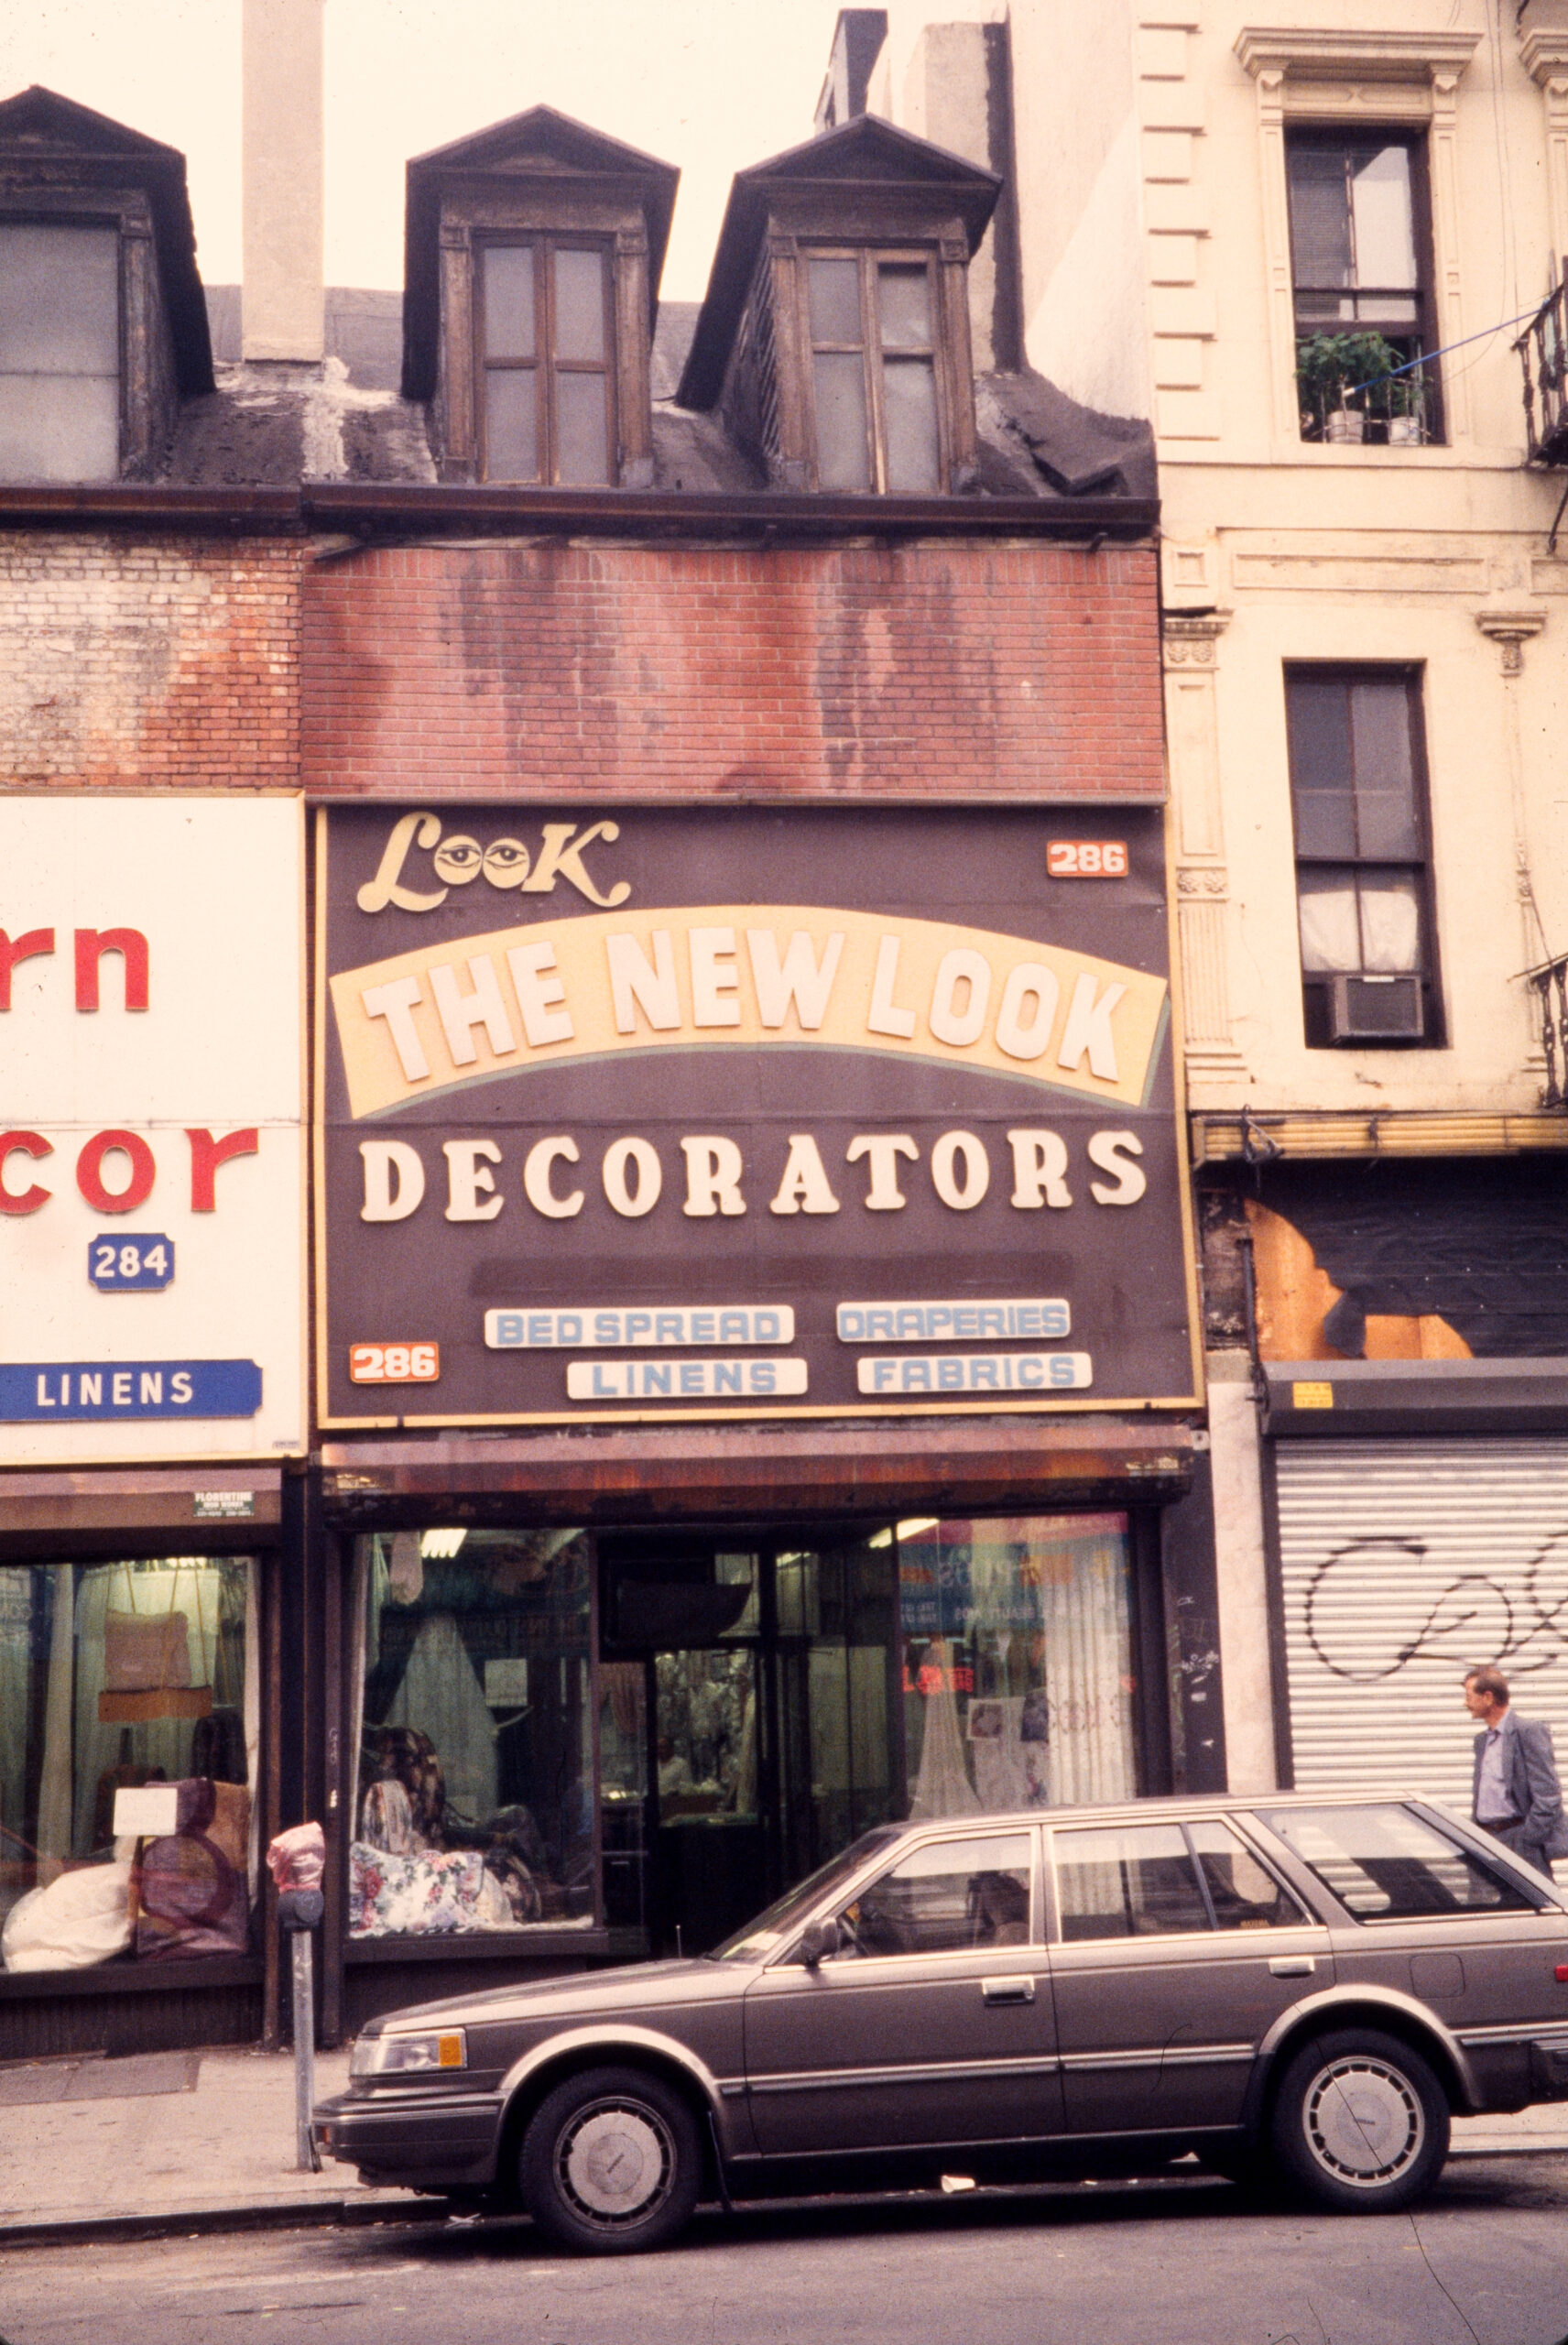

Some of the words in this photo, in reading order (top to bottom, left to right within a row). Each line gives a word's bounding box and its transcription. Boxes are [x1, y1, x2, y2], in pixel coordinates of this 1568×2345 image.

[1050, 843, 1125, 874] 286
[362, 941, 574, 1082] THE
[605, 926, 845, 1033] NEW
[867, 934, 1128, 1083] LOOK
[359, 1130, 1147, 1222] DECORATORS
[93, 1245, 169, 1280] 284
[497, 1314, 583, 1345] BED
[594, 1312, 780, 1344] SPREAD
[838, 1303, 1068, 1340] DRAPERIES
[354, 1346, 435, 1380] 286
[593, 1362, 777, 1395] LINENS
[873, 1355, 1075, 1391] FABRICS
[37, 1371, 194, 1408] LINENS
